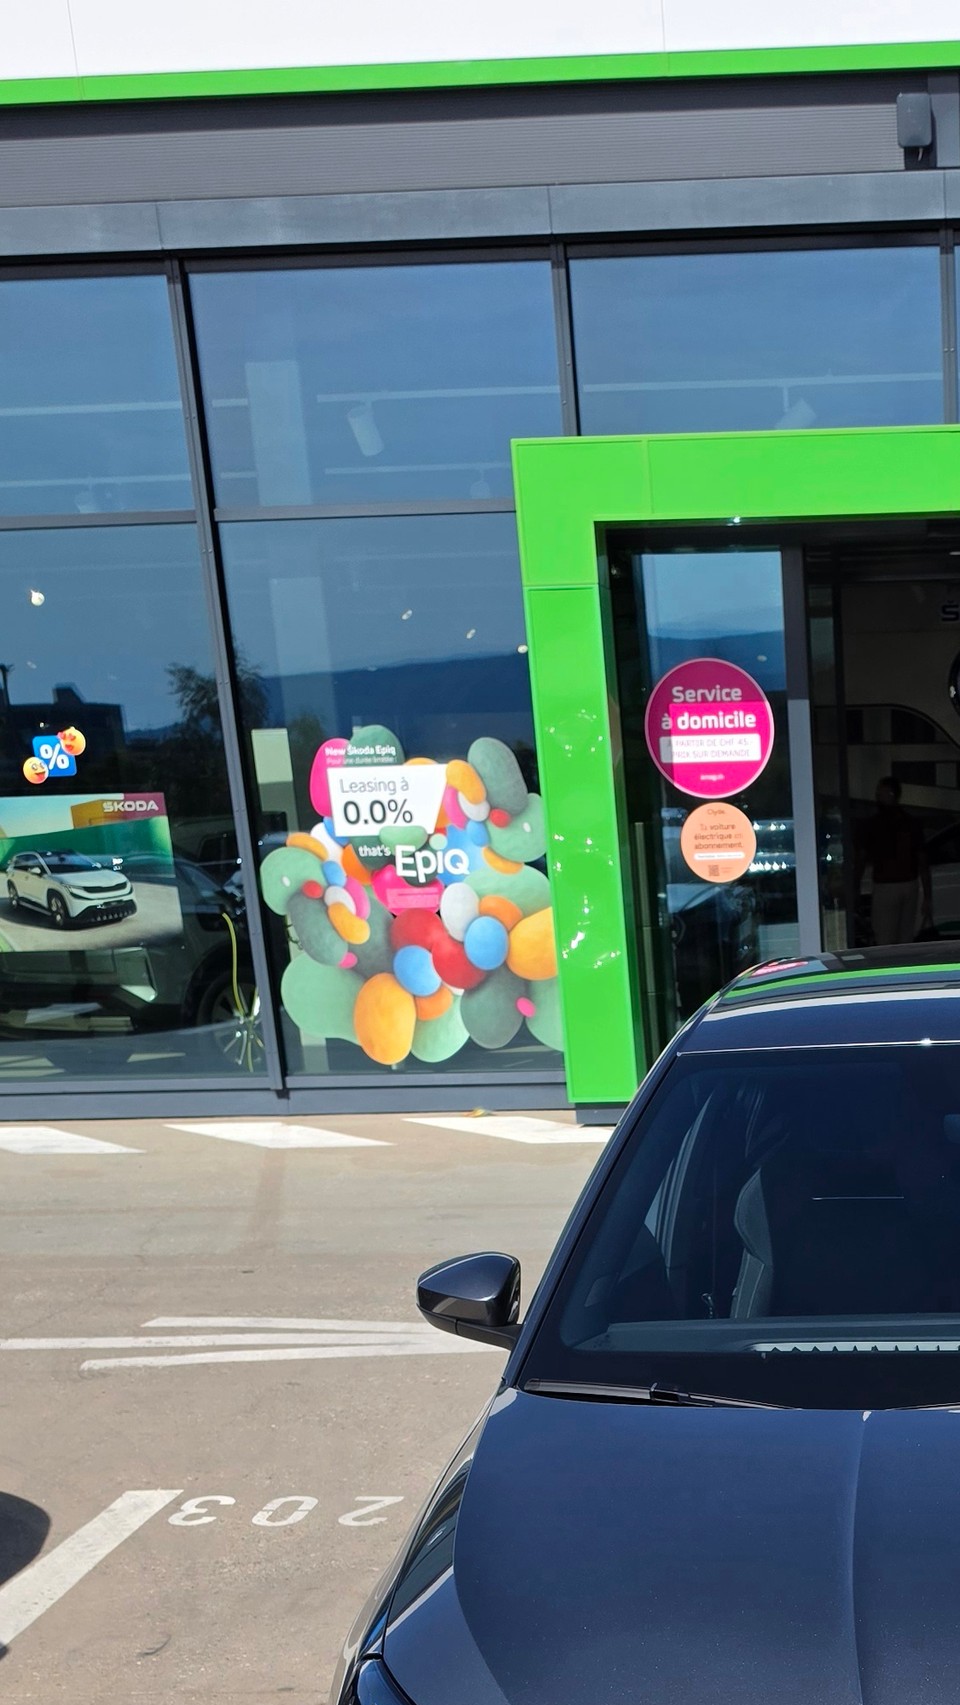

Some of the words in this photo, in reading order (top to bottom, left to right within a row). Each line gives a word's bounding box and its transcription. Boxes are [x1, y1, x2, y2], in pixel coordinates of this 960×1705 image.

[671, 684, 742, 703] Service
[661, 712, 672, 730] à
[677, 710, 756, 730] domicile
[340, 777, 396, 795] Leasing
[400, 777, 410, 791] à
[343, 799, 413, 825] 0.0%
[358, 844, 391, 857] that's
